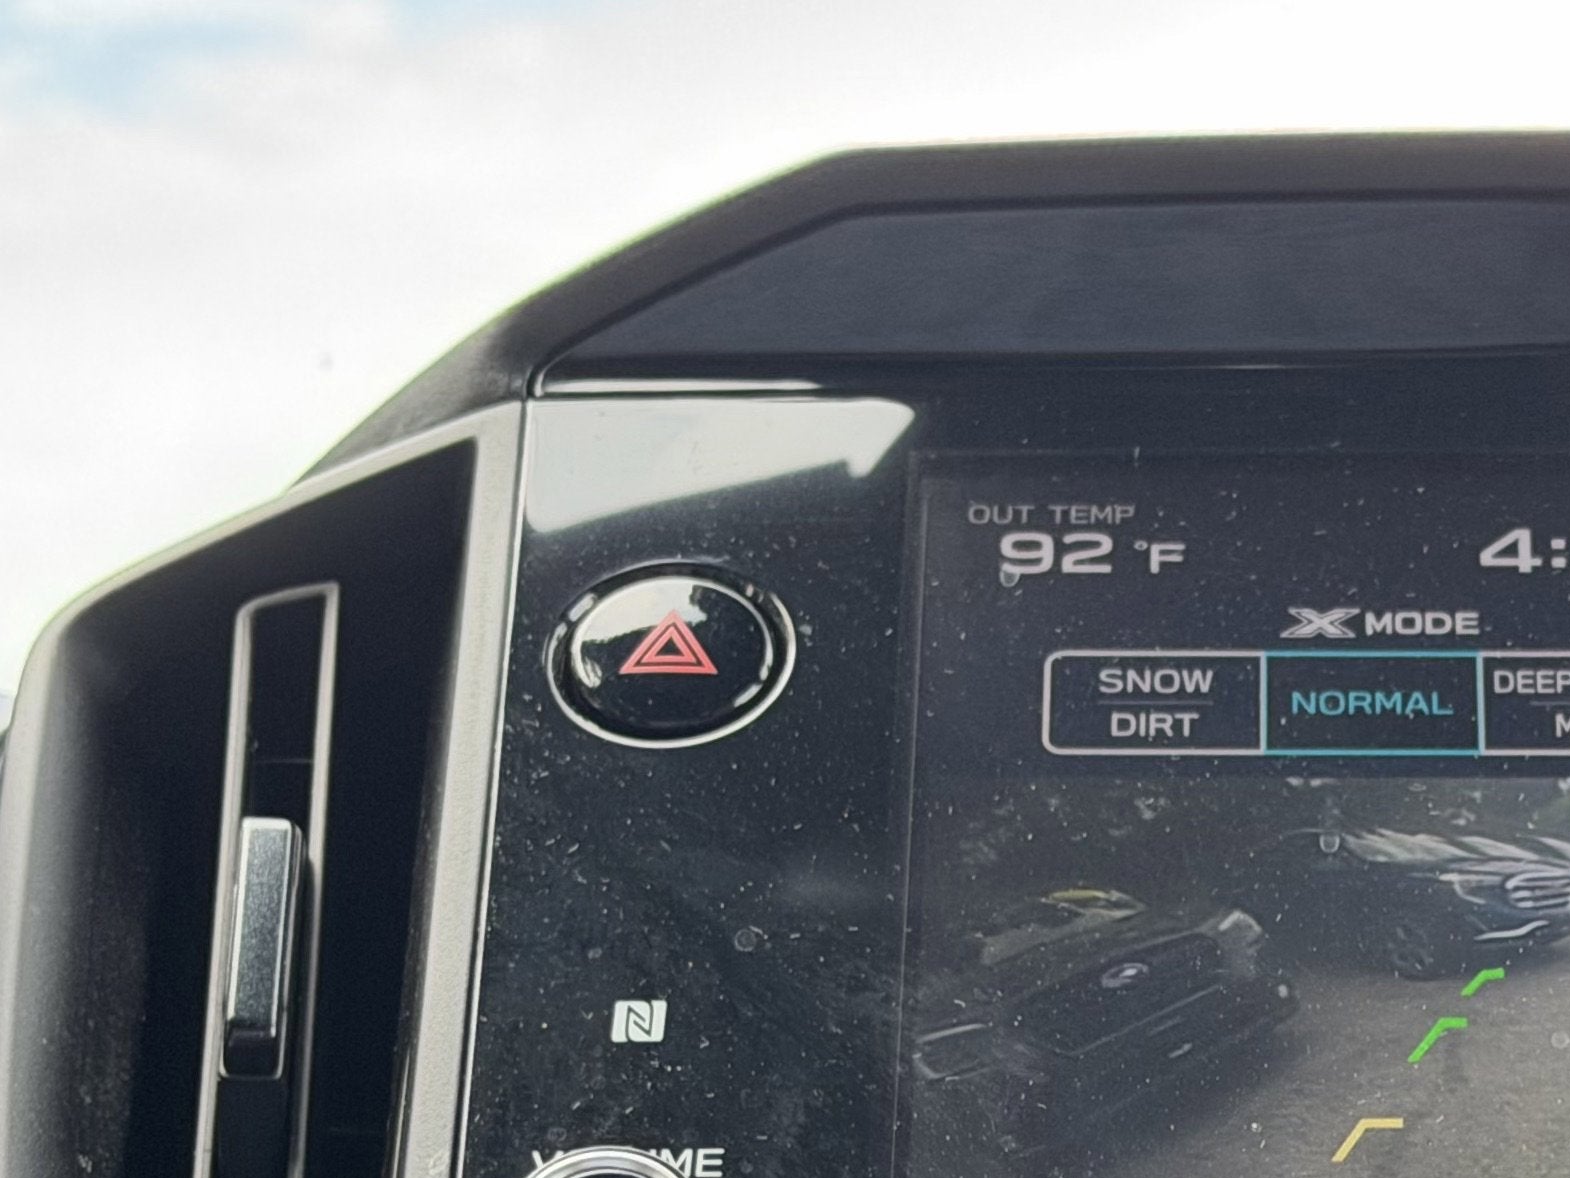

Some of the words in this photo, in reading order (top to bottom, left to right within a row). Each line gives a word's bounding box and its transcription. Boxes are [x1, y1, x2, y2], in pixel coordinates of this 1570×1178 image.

[967, 504, 1035, 525] OUT
[1048, 504, 1137, 525] TEMP
[999, 531, 1114, 575] 92
[1099, 668, 1214, 694] SNOW
[1291, 690, 1454, 716] NORMAL
[1110, 711, 1200, 737] DIRT
